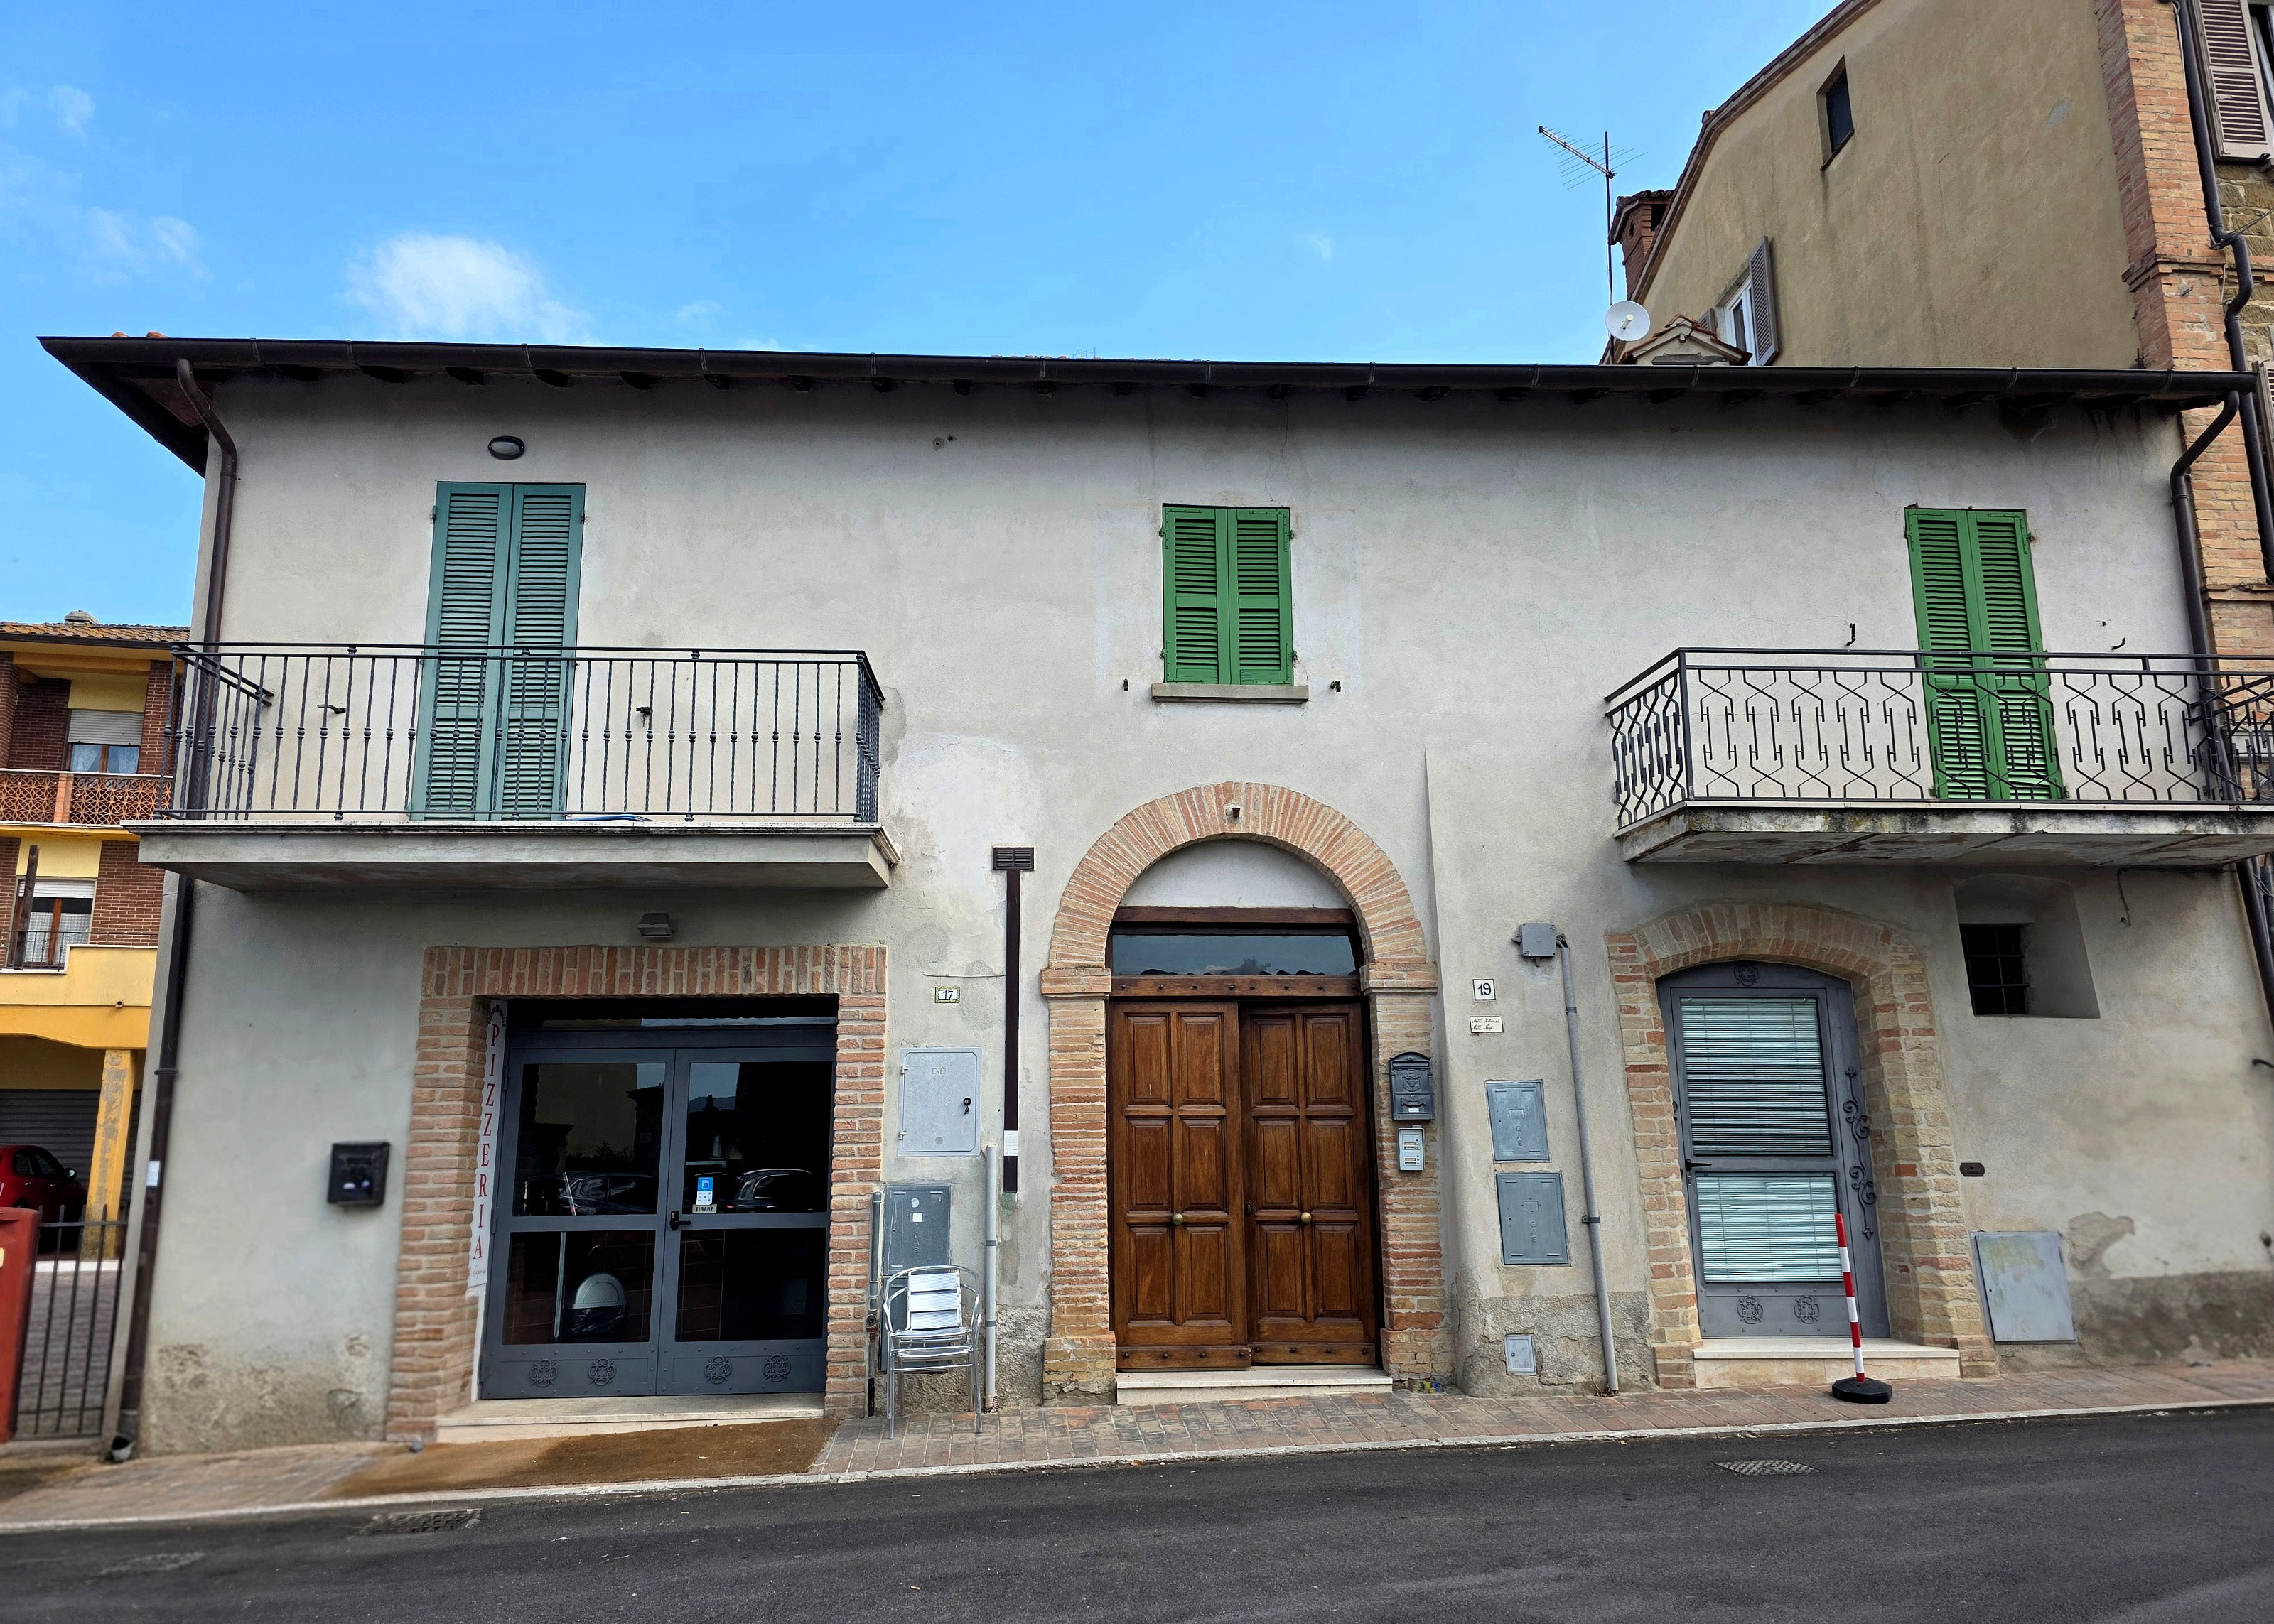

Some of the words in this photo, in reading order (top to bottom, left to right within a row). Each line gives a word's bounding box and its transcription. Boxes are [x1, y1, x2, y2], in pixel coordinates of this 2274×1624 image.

[943, 990, 954, 1000] 17
[1477, 982, 1492, 996] 19
[473, 1024, 500, 1260] PIZZERIA
